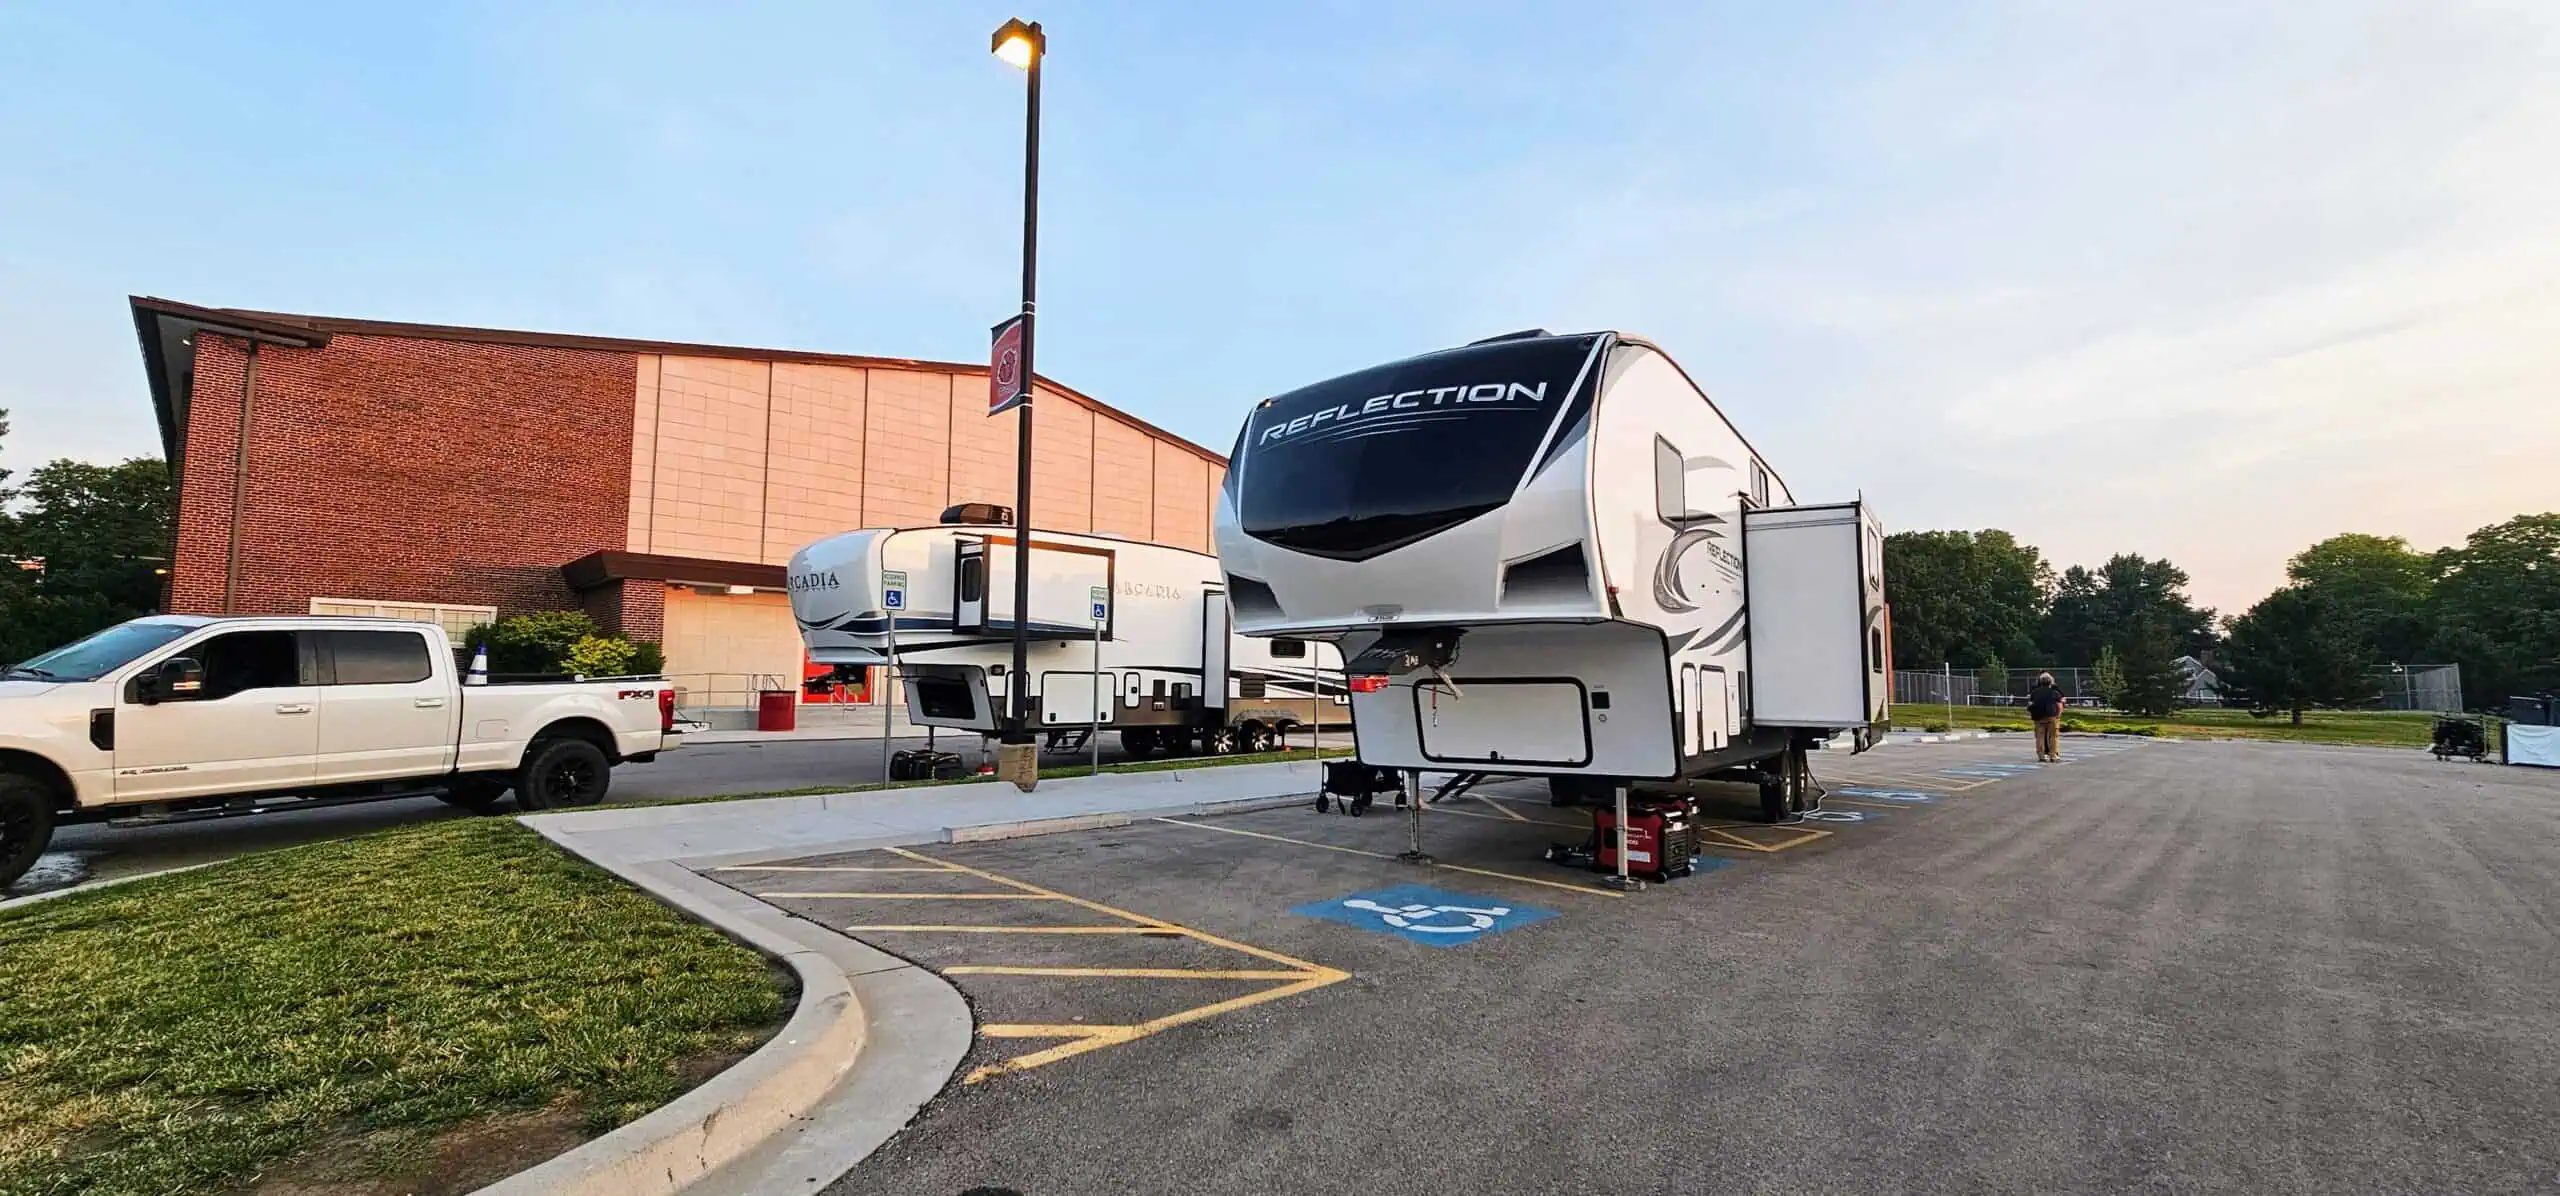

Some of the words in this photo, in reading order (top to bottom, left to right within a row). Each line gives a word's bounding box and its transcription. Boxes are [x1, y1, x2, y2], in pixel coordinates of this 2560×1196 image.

[1259, 381, 1548, 446] REFLECTION
[788, 571, 840, 591] RCADIA
[618, 689, 654, 700] FX4
